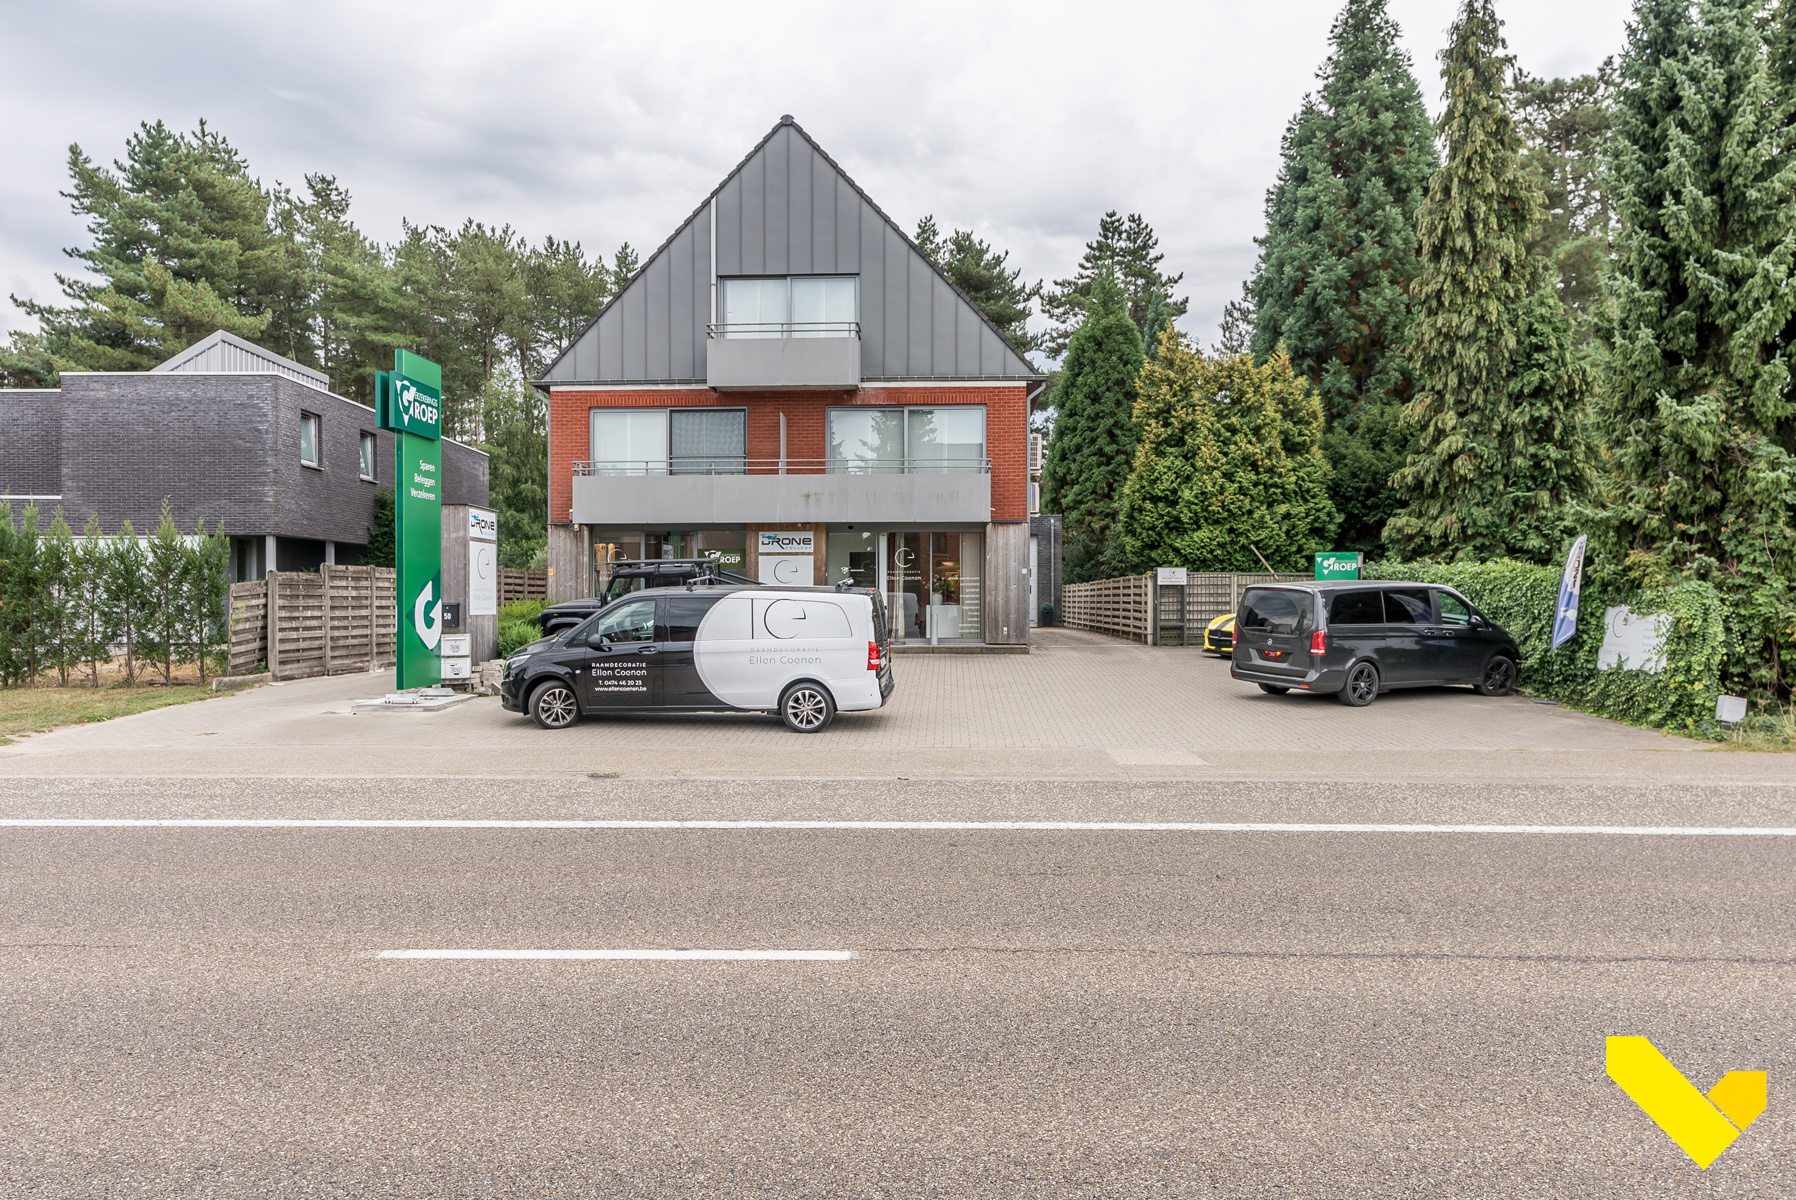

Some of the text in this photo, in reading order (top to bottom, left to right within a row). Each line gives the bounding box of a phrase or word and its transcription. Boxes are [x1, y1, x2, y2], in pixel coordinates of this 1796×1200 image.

[419, 459, 435, 472] Sparen
[414, 472, 435, 487] Beleggen
[410, 487, 435, 500] Verzekeren
[443, 612, 452, 620] 50
[749, 655, 822, 665] Ellen Coenen
[591, 668, 647, 676] Ellen Coenen
